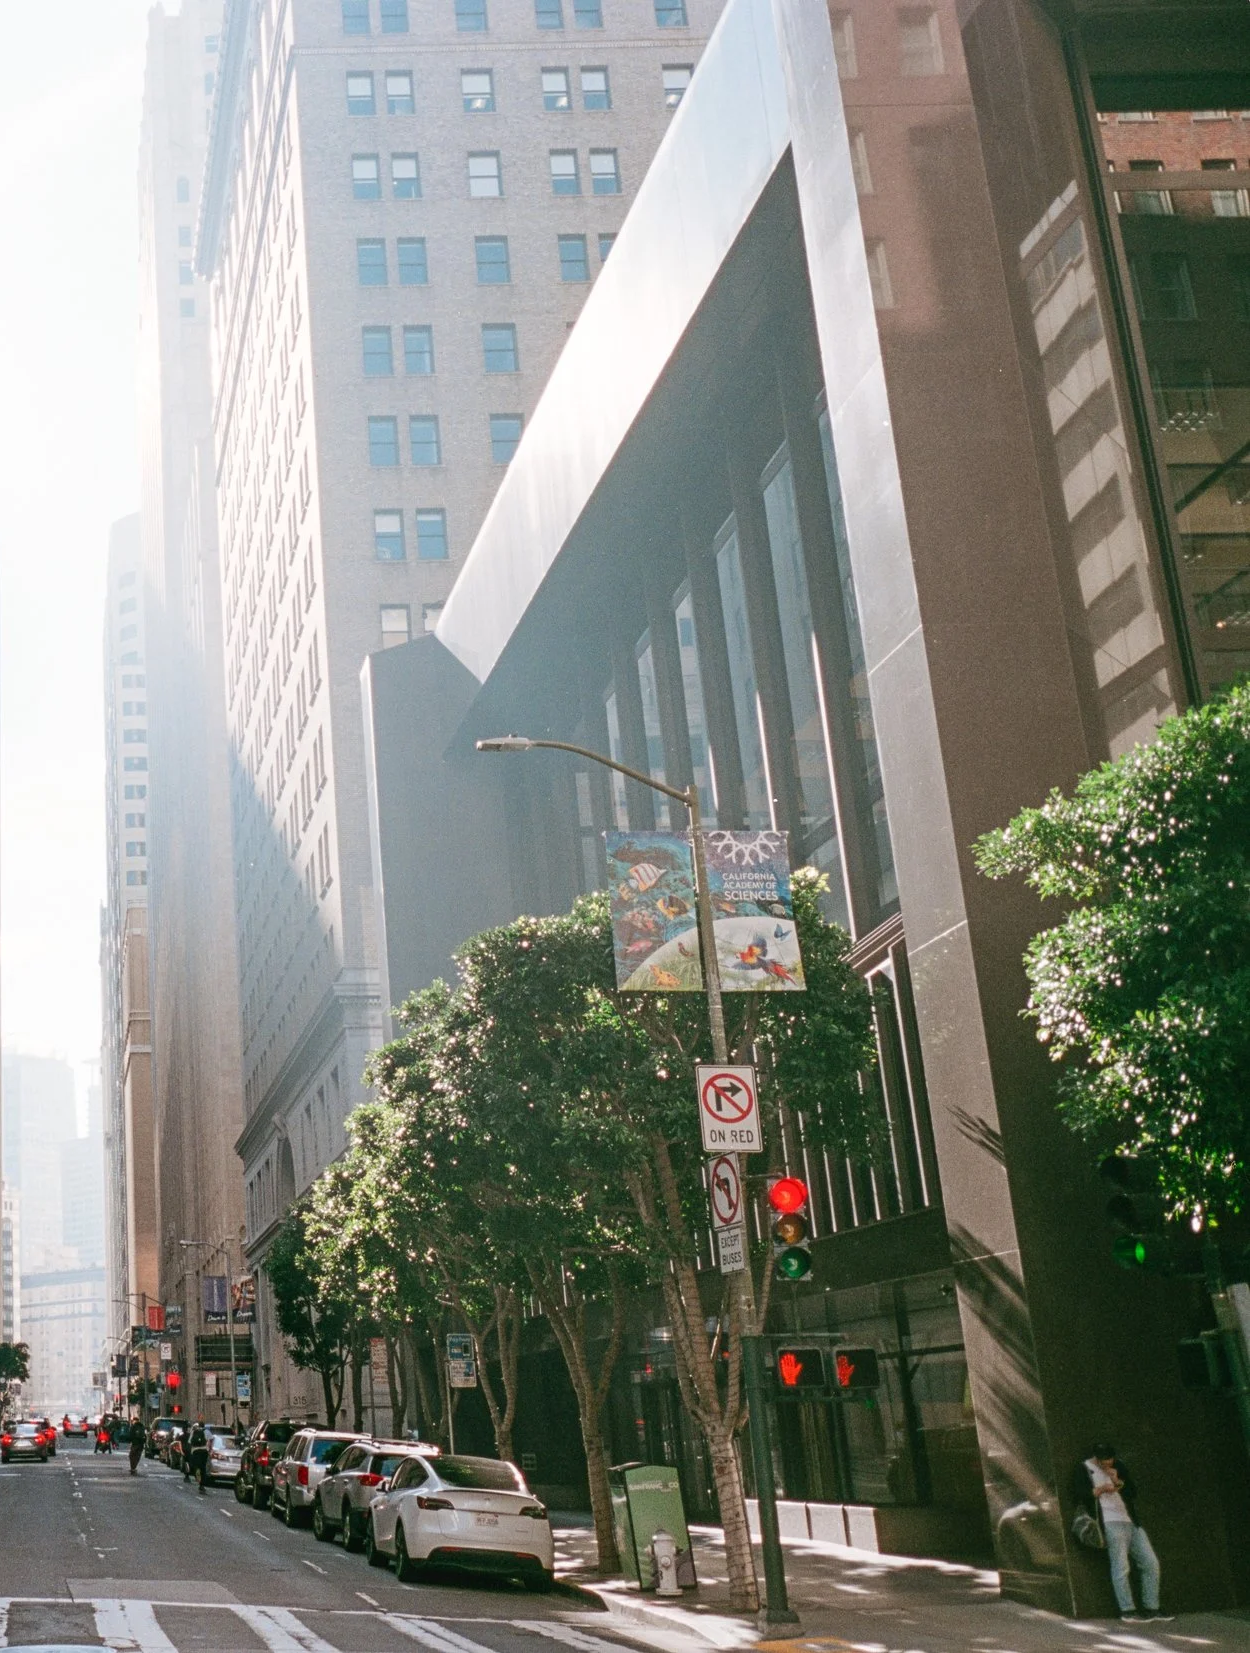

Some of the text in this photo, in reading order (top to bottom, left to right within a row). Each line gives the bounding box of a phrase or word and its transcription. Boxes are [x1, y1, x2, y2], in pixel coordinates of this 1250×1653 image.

[722, 872, 776, 882] CALIFORNIA
[723, 882, 765, 890] ACADEMY
[724, 890, 779, 901] SCIENCES
[710, 1129, 754, 1143] ON RED
[721, 1236, 740, 1248] EXCEPT
[722, 1252, 742, 1265] BUSES
